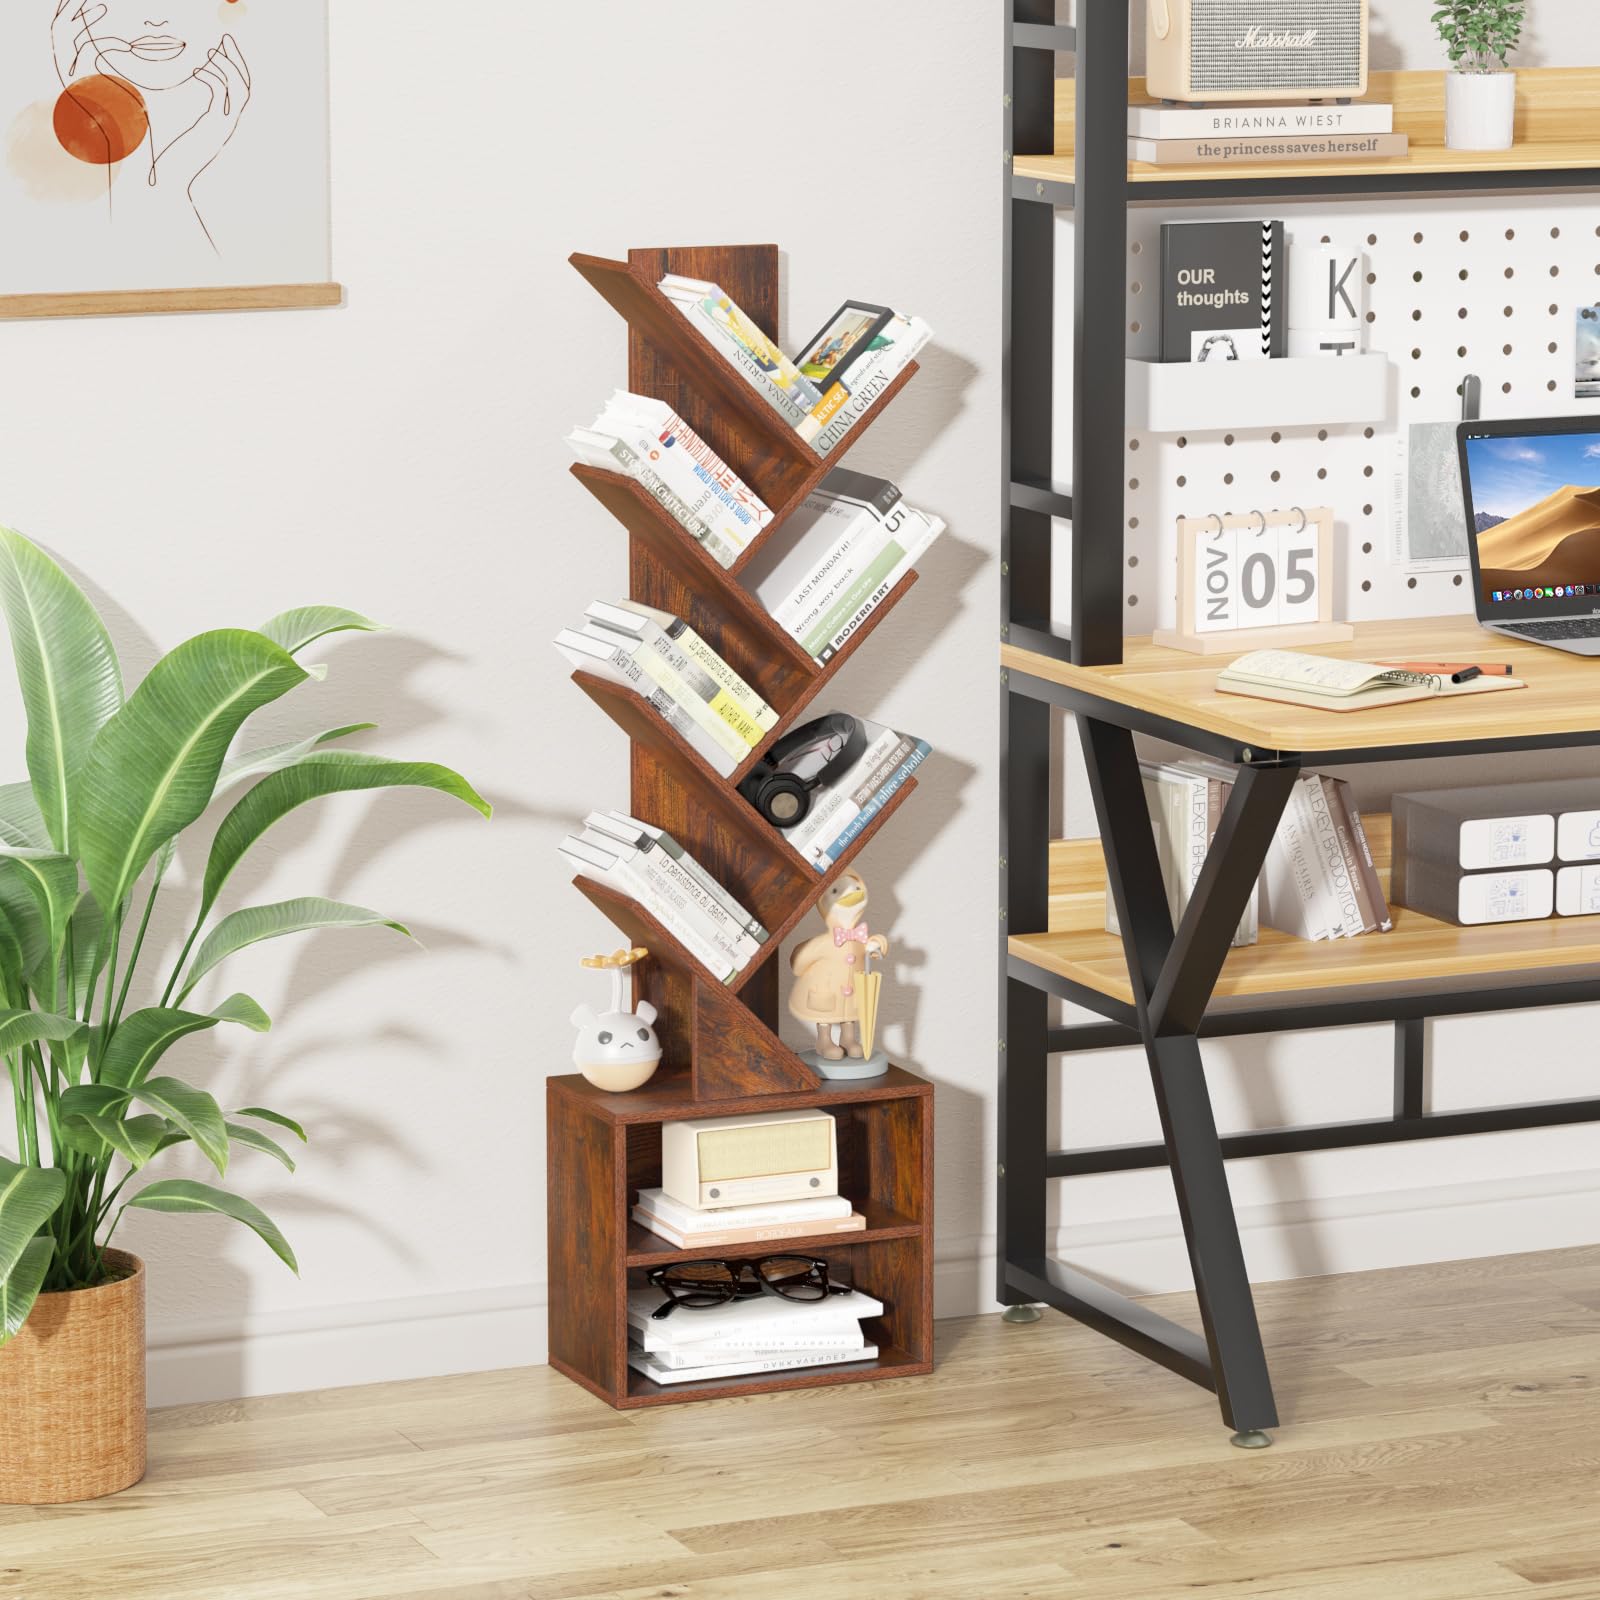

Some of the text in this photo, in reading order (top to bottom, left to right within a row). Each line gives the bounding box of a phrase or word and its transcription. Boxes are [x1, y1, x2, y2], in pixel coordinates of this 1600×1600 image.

[1234, 25, 1318, 49] Marshall
[1213, 114, 1343, 129] BRIANNA WIEST
[1197, 138, 1378, 159] the princess saves herself
[1177, 268, 1216, 286] OUR
[1176, 289, 1250, 309] thoughts
[732, 348, 768, 384] GREEN
[766, 381, 802, 419] CHINA
[817, 406, 857, 453] CHINA
[850, 371, 890, 415] GREEN
[794, 584, 813, 606] LAST
[811, 551, 844, 585] MONDAY
[833, 566, 855, 590] back
[1206, 547, 1229, 620] NOV
[1241, 548, 1315, 609] 05
[834, 582, 891, 646] MODERN ART
[879, 778, 900, 803] alice
[897, 748, 926, 783] sebold
[1192, 784, 1206, 840] ALEXEY
[1305, 783, 1333, 834] ALEXEY
[666, 864, 702, 899] persistance
